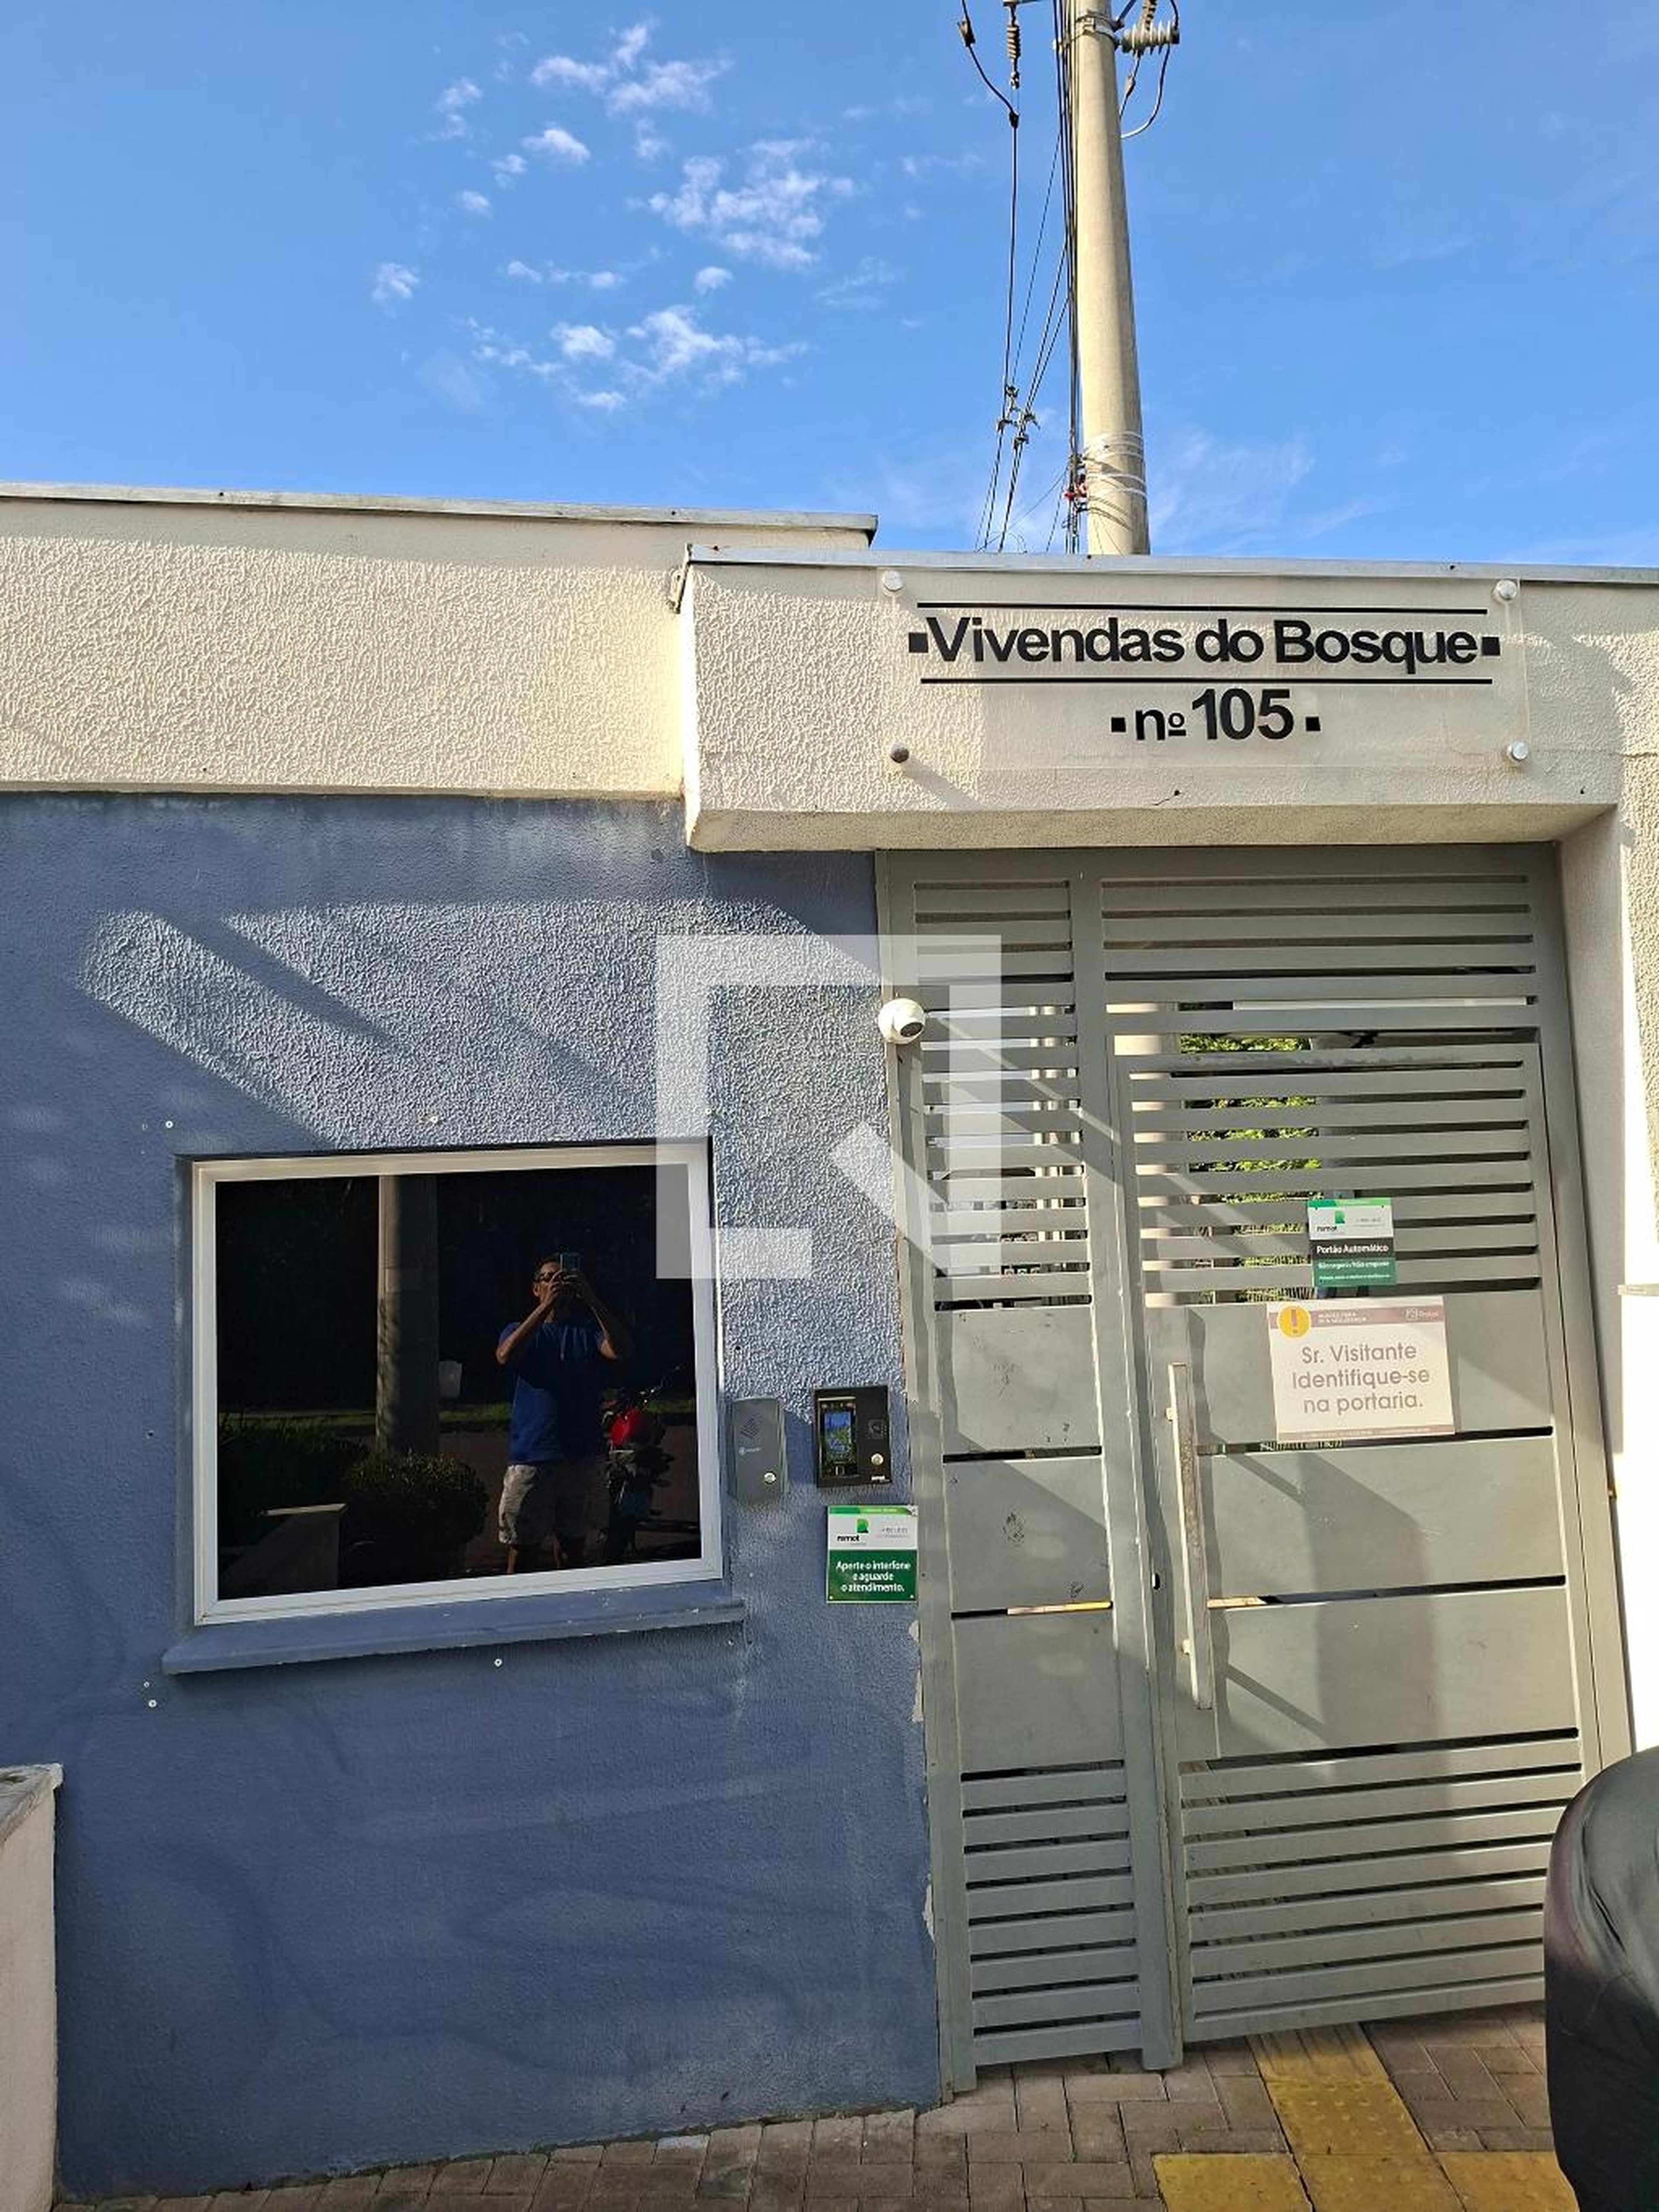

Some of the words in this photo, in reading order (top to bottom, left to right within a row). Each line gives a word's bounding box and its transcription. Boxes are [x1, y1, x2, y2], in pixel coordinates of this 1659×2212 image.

[925, 617, 1185, 662] Vivendas
[1195, 618, 1264, 663] do
[1274, 620, 1478, 675] Bosque
[1302, 1346, 1324, 1363] Sr.
[1329, 1342, 1417, 1362] Visitante
[1292, 1369, 1430, 1389] Identifique-se
[1304, 1400, 1329, 1413] na
[1337, 1391, 1423, 1415] portaria.
[836, 1561, 865, 1572] Aperte
[873, 1560, 911, 1570] interfone
[848, 1582, 905, 1592] atendimento.
[858, 1572, 894, 1582] aguarde
